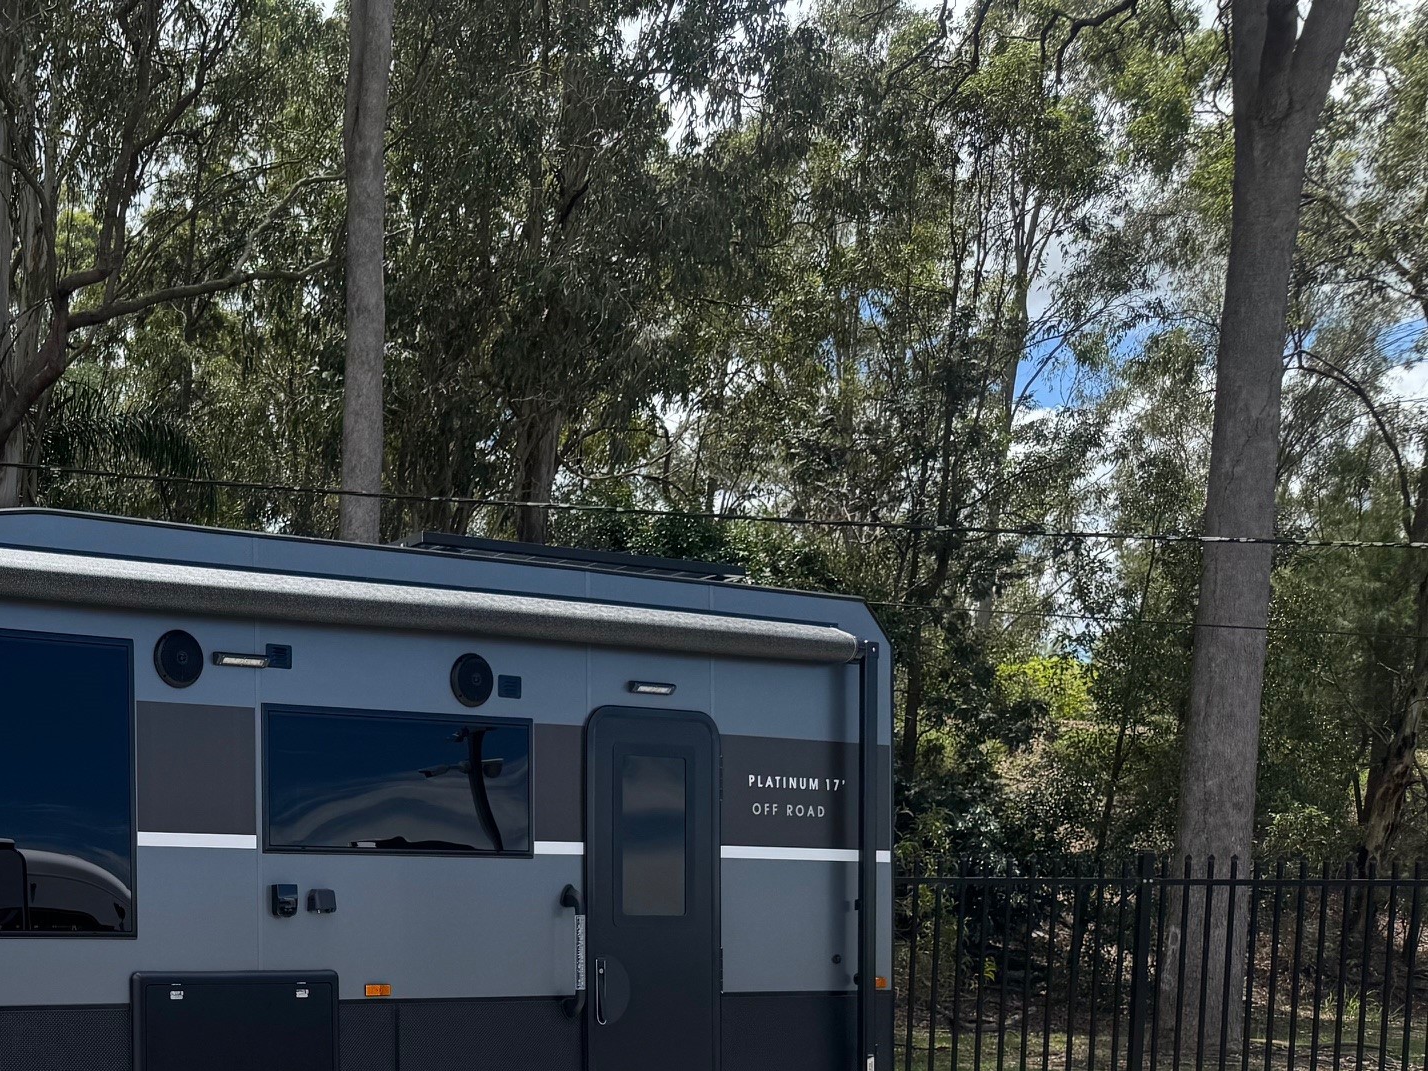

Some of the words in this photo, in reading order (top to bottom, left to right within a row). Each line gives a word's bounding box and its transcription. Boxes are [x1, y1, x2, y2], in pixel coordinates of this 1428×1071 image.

[748, 774, 819, 791] PLATINUM
[752, 802, 778, 816] OFF
[786, 804, 826, 818] ROAD
